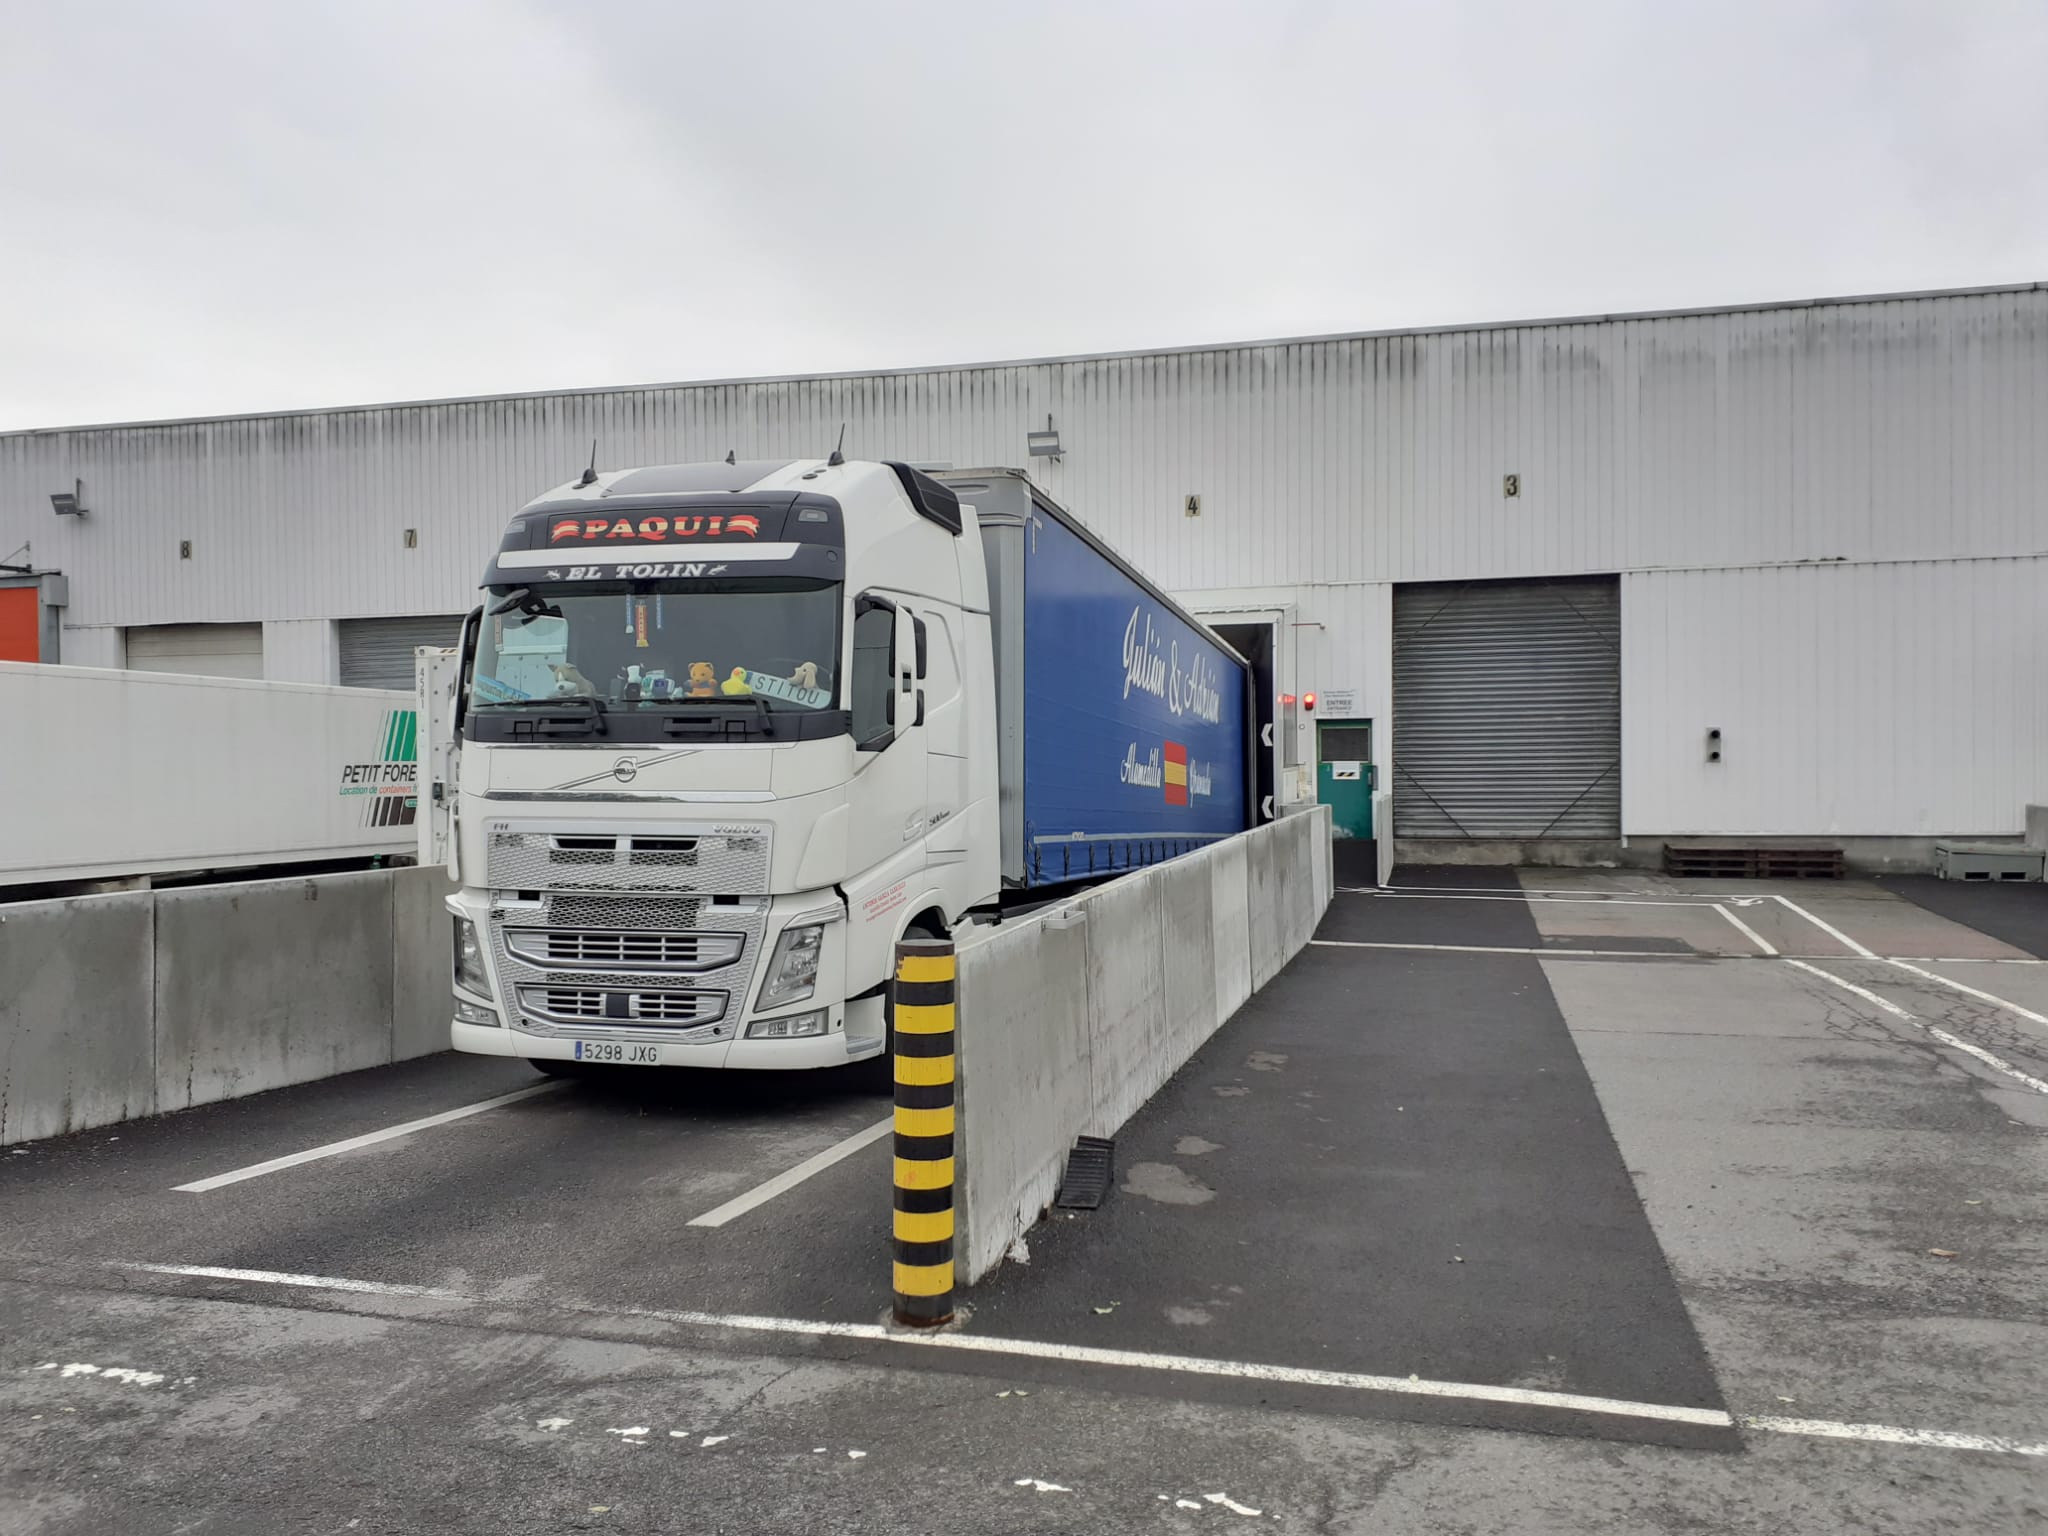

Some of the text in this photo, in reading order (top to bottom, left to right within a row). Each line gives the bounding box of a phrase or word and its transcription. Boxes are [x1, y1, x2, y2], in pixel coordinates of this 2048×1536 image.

[1506, 474, 1518, 496] 3
[1187, 495, 1198, 515] 4
[582, 516, 724, 541] PAQUI
[406, 529, 415, 548] 7
[182, 541, 190, 559] 8
[565, 563, 706, 580] EL TOLIN
[1169, 639, 1183, 716] &
[755, 676, 820, 704] STITOU
[341, 764, 418, 783] PETIT FORE
[339, 784, 368, 795] Location
[368, 784, 378, 794] de
[493, 823, 509, 831] FH
[711, 824, 761, 834] VOLVO
[584, 1043, 657, 1062] 5298 JXG
